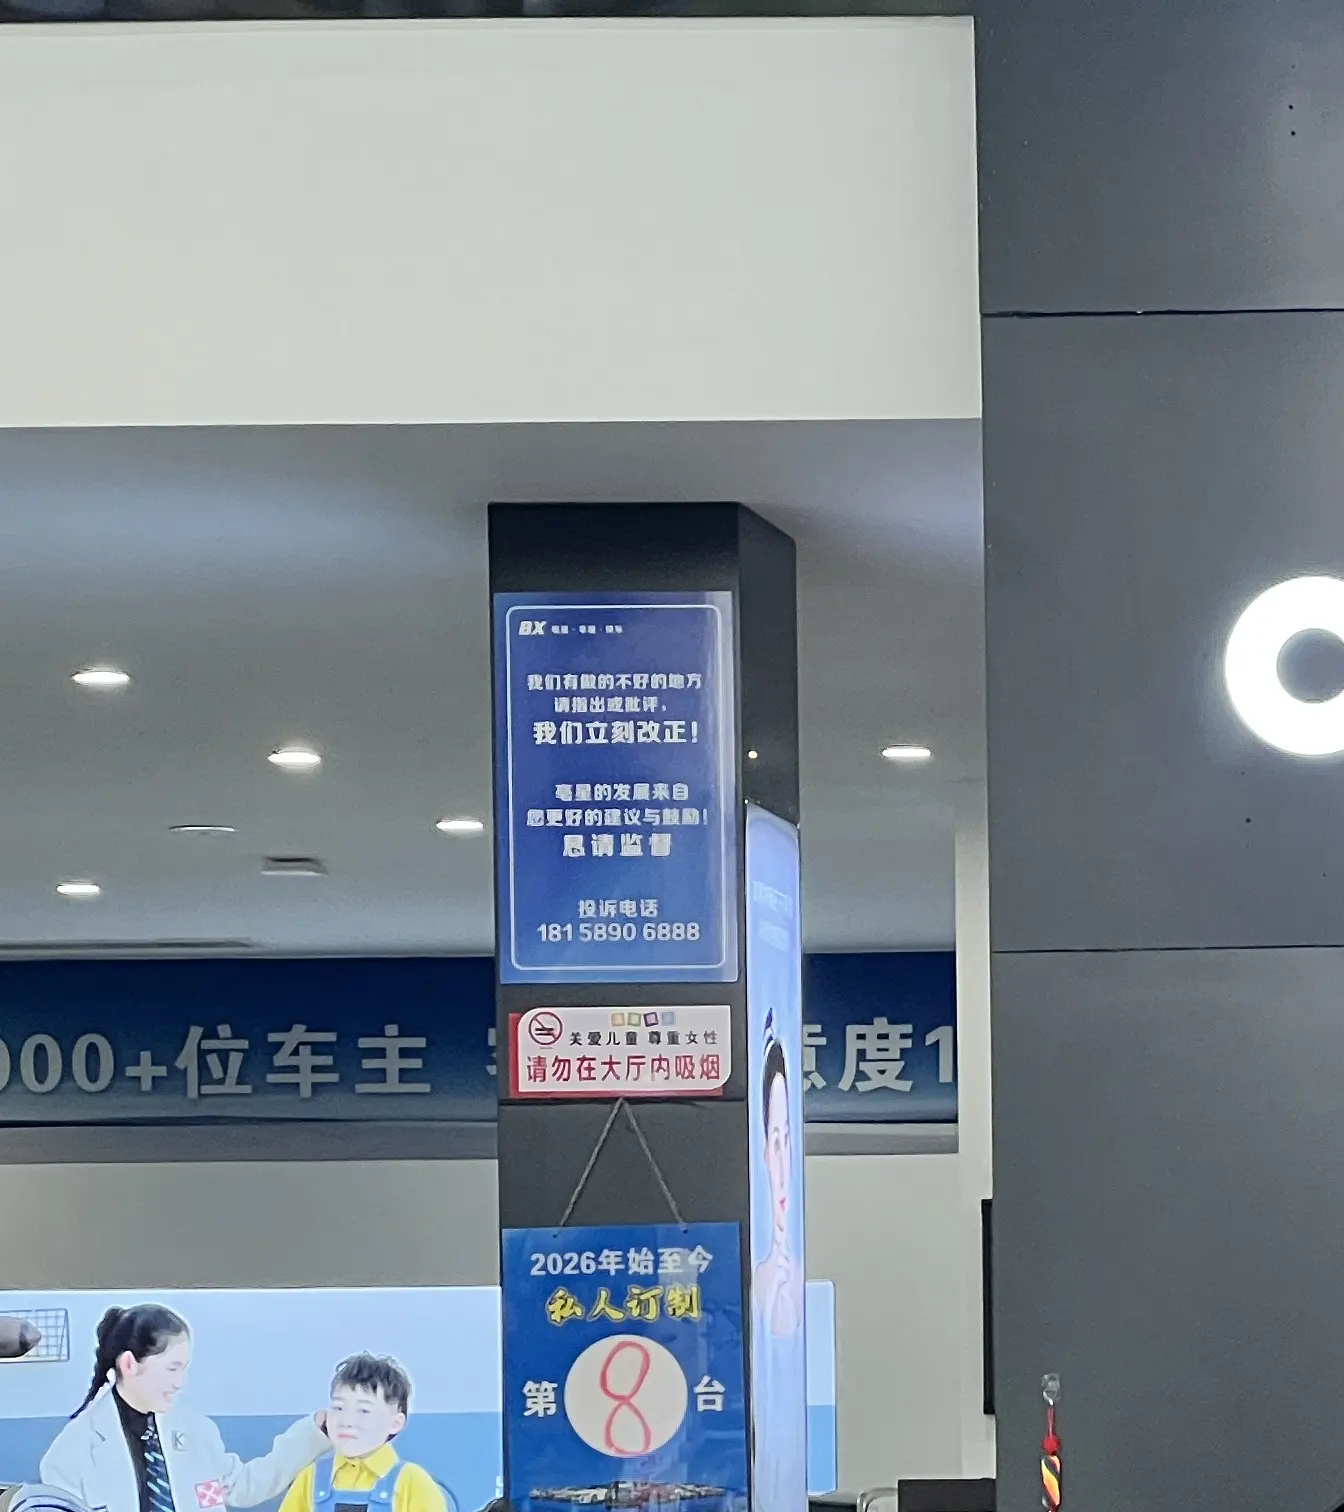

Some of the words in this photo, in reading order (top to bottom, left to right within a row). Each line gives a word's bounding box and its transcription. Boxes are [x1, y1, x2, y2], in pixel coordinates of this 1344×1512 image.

[533, 720, 699, 745] 我们立刻改正！
[578, 899, 659, 918] 投诉电话
[537, 923, 573, 942] 181
[579, 923, 637, 942] 5890
[642, 922, 701, 941] 6888
[569, 1031, 639, 1047] 关爱儿童
[0, 1023, 431, 1099] 00+位车主
[526, 1053, 721, 1083] 请勿在大厅内吸烟
[530, 1246, 714, 1276] 2026年始至今
[547, 1286, 703, 1326] 私人订制
[522, 1380, 558, 1417] 第
[599, 1340, 651, 1455] 8
[693, 1375, 727, 1412] 台
